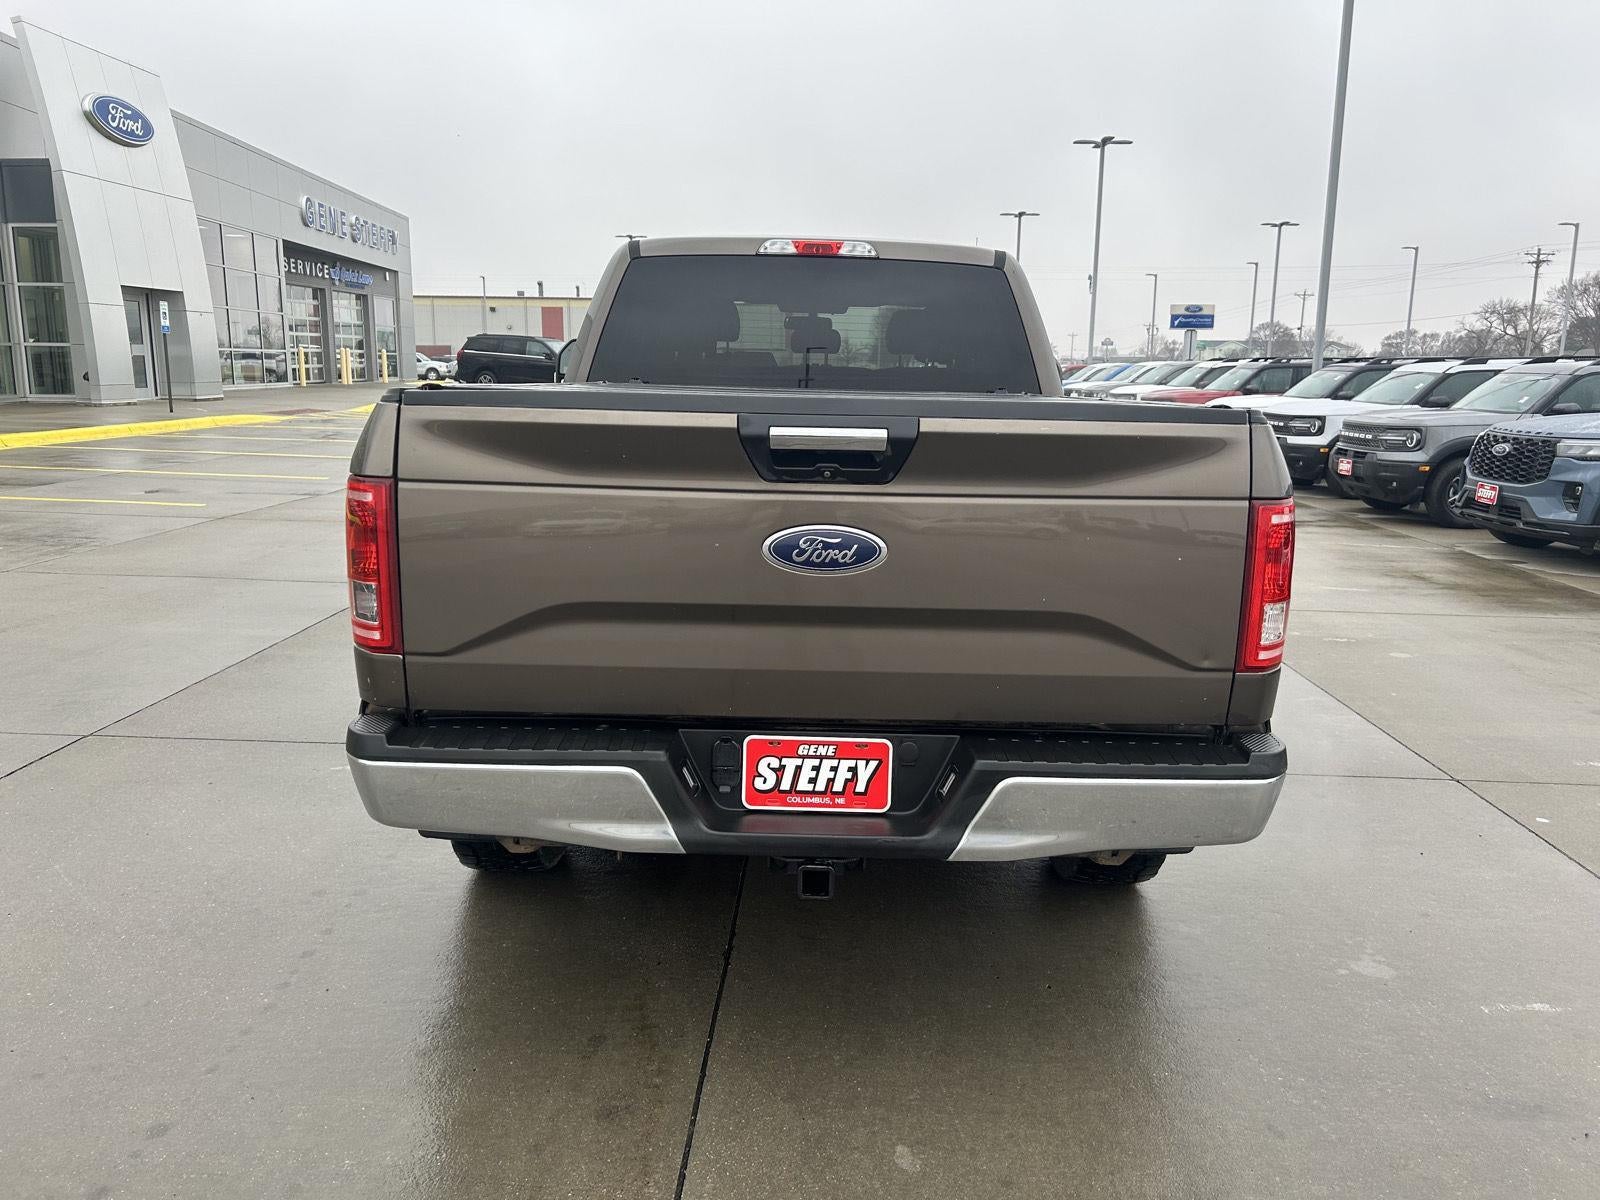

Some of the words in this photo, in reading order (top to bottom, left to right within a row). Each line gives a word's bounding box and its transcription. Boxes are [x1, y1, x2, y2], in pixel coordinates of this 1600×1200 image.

[108, 103, 144, 135] Ford
[301, 195, 349, 239] GENE
[351, 215, 399, 255] STEFFY
[283, 257, 330, 279] SERVICE
[792, 535, 858, 563] Ford
[797, 744, 837, 756] GENE
[753, 756, 882, 795] STEFFY
[786, 796, 833, 805] COLUMBUS,
